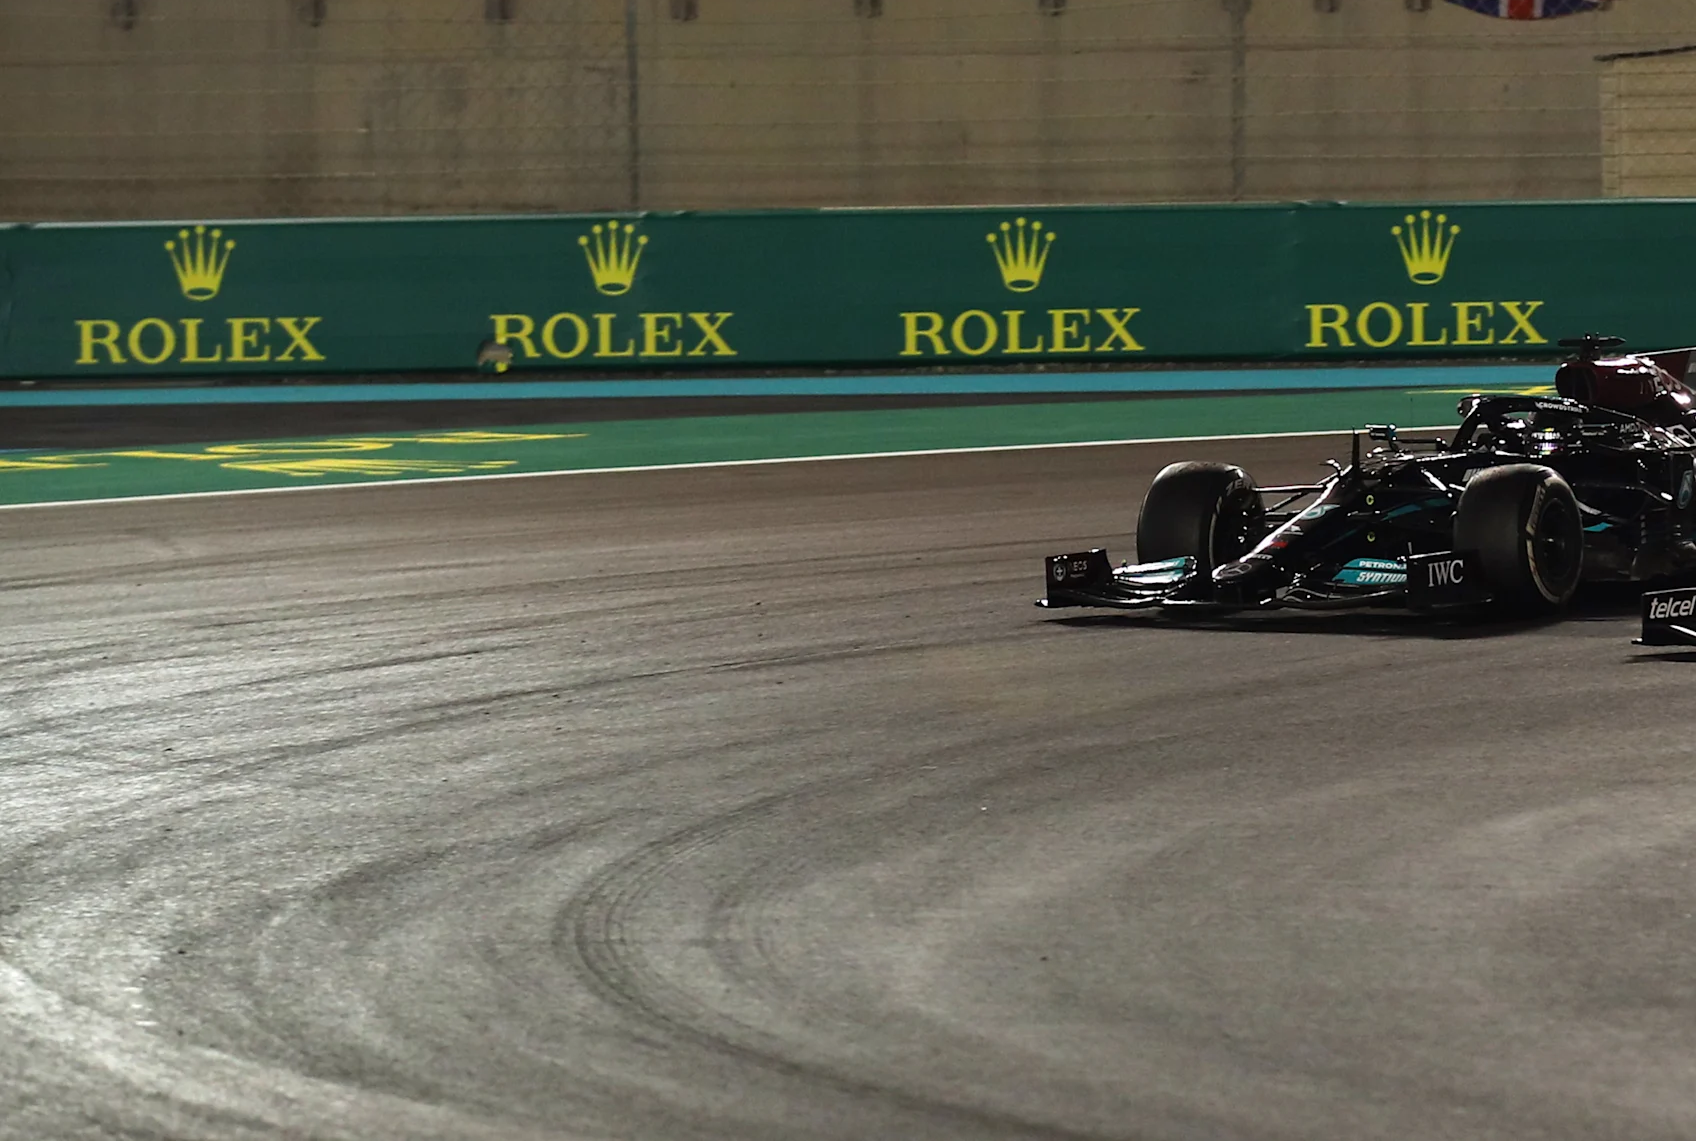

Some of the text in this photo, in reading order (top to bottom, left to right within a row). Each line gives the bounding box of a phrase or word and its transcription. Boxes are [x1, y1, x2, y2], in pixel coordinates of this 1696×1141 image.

[75, 316, 327, 364] ROLEX
[489, 312, 738, 358] ROLEX
[899, 307, 1146, 354] ROLEX
[1306, 301, 1548, 348] ROLEX
[1428, 559, 1464, 587] IWC
